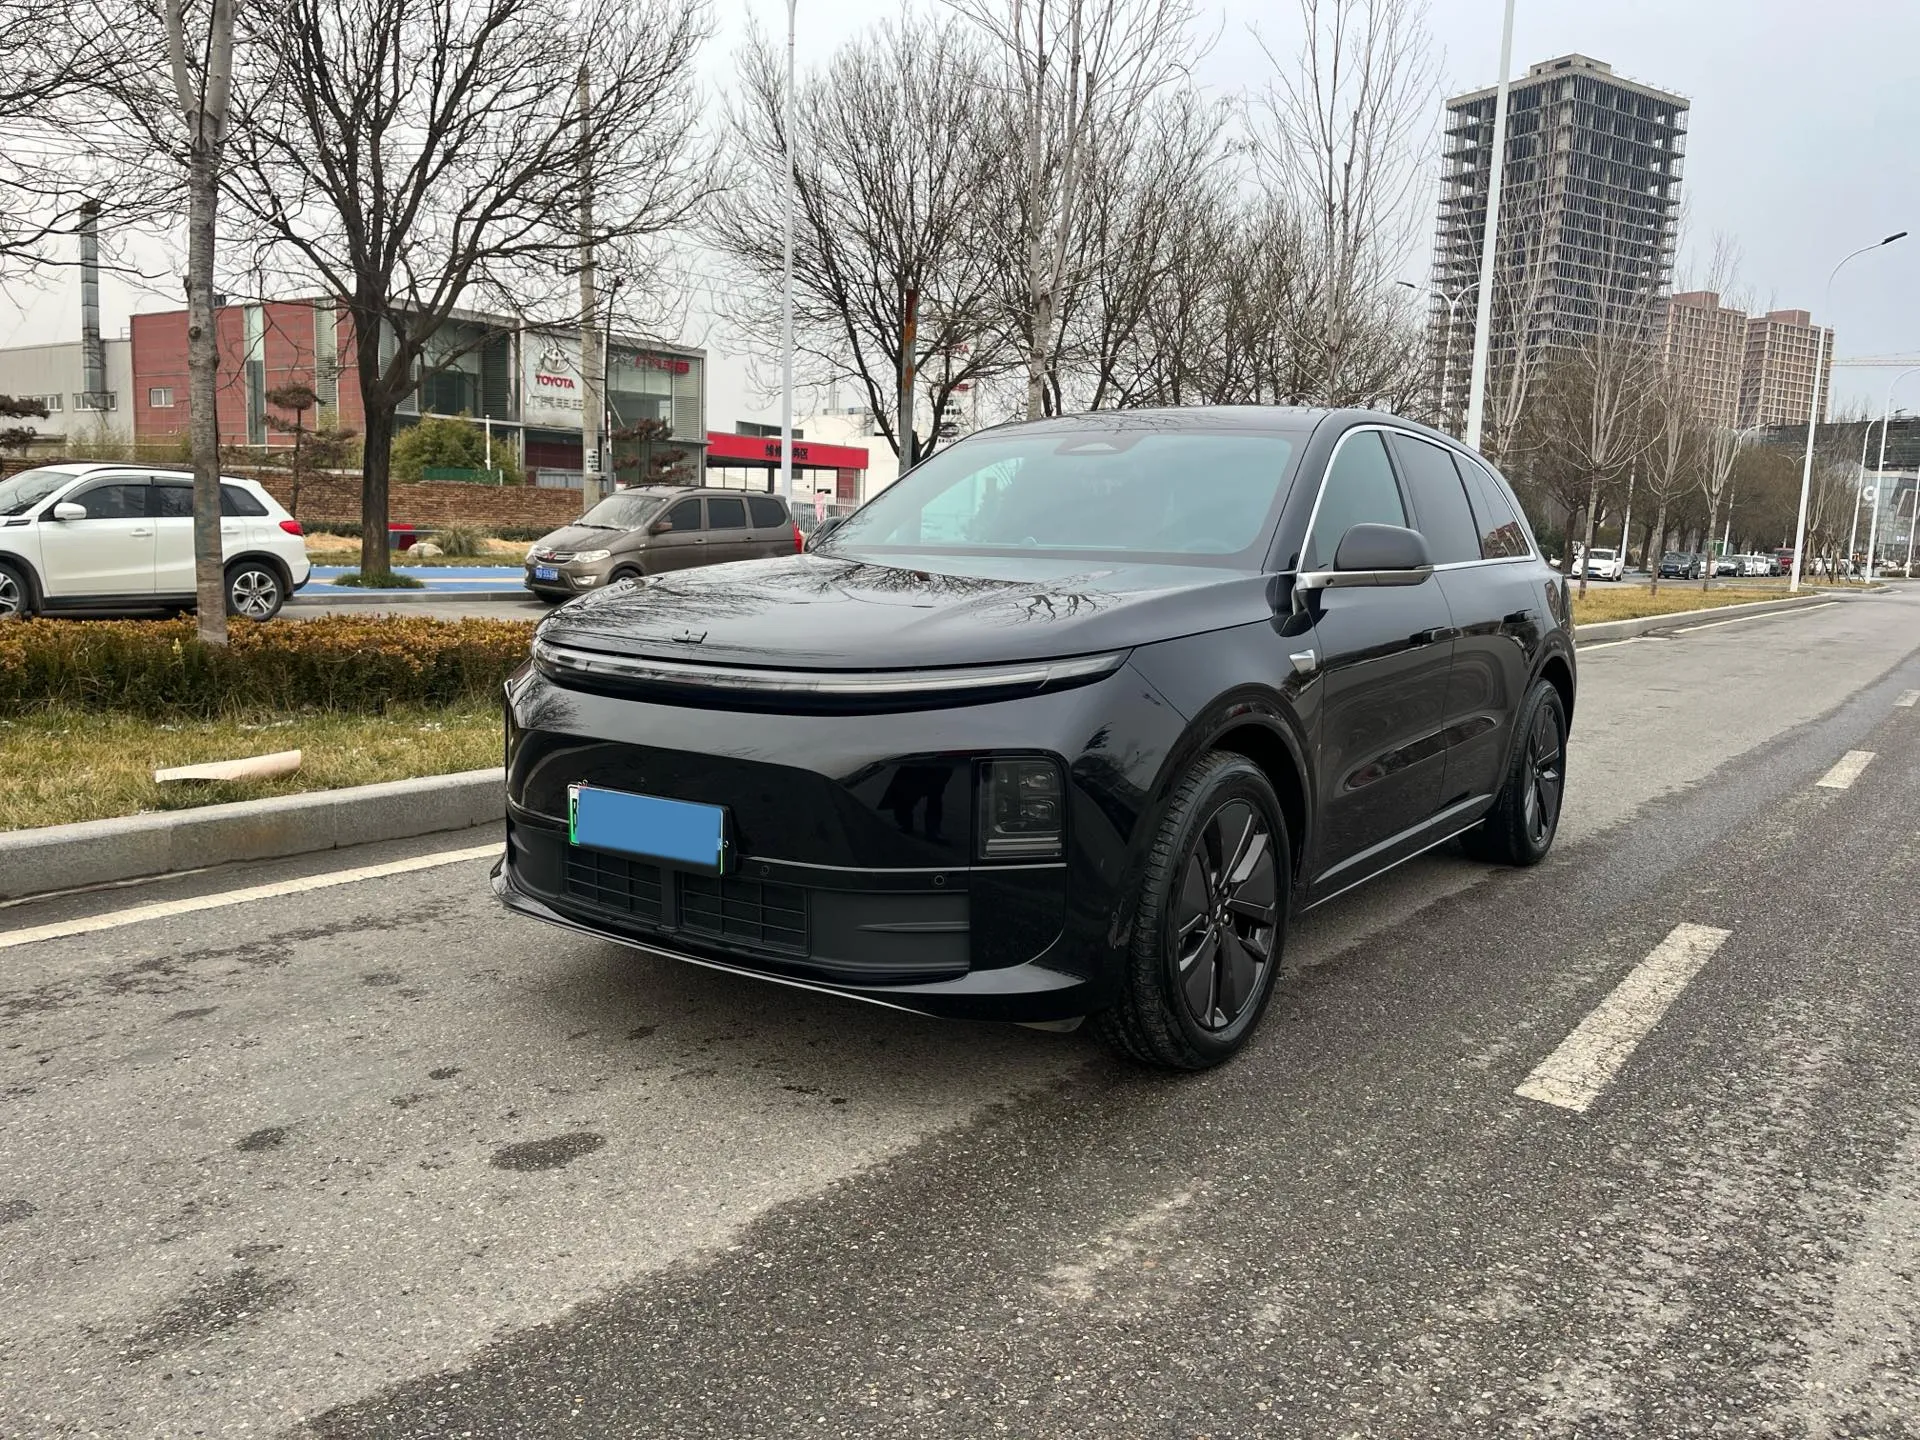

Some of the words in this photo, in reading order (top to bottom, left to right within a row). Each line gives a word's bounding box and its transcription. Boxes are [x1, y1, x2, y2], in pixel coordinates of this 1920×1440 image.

[536, 375, 575, 389] TOYOTA
[765, 443, 809, 461] 维修务区
